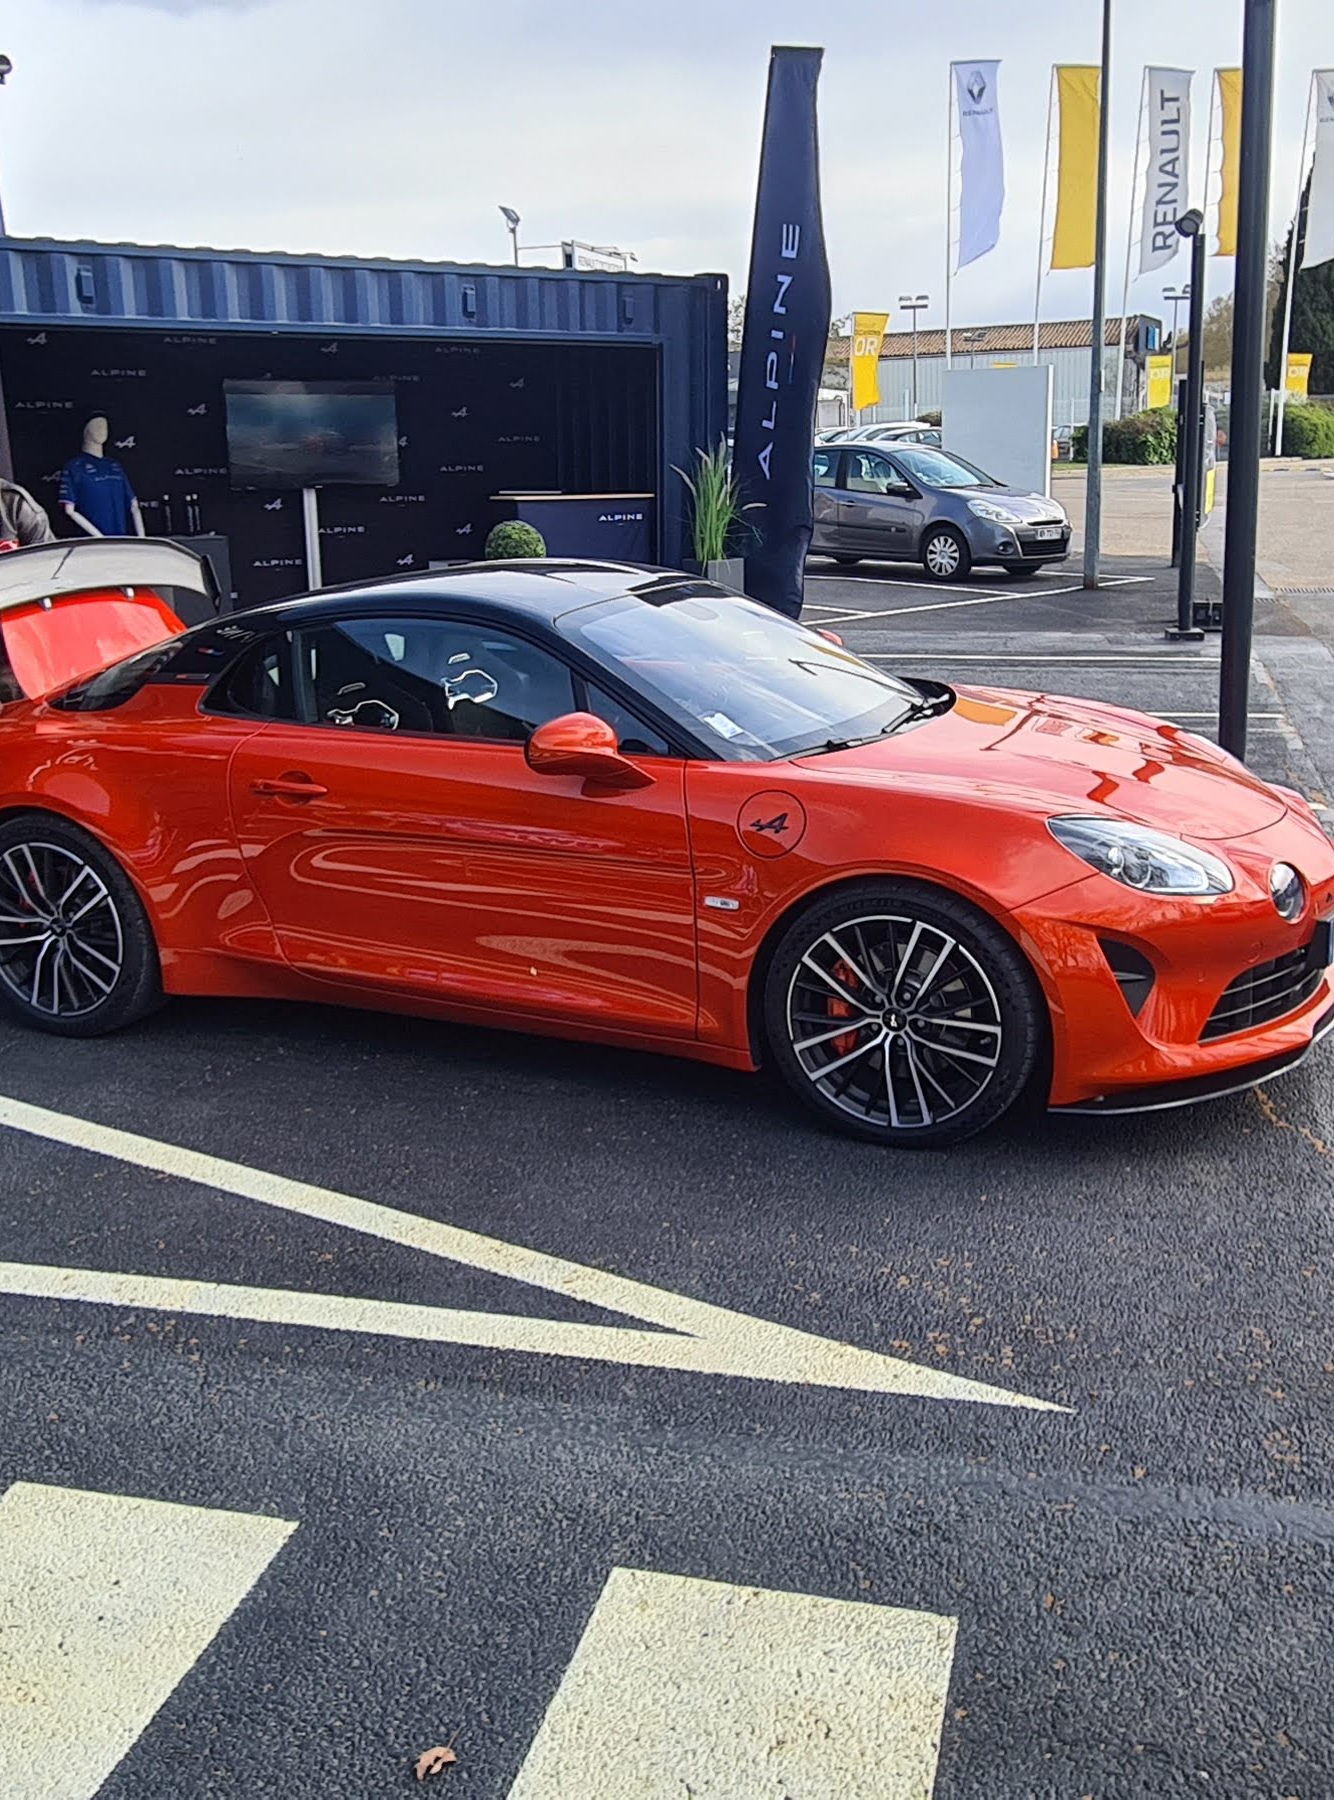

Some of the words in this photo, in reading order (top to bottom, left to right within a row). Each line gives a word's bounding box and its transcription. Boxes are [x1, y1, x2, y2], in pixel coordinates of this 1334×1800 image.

[962, 107, 994, 117] RENAULT
[1152, 89, 1181, 253] RENAULT
[163, 336, 216, 344] ALPINE
[854, 336, 878, 356] OR
[758, 223, 800, 480] ALPINE
[90, 369, 146, 377] ALPINE
[15, 401, 73, 409] ALPINE
[175, 468, 227, 476] ALPINE
[598, 513, 643, 521] ALPINE
[253, 559, 302, 567] ALPINE
